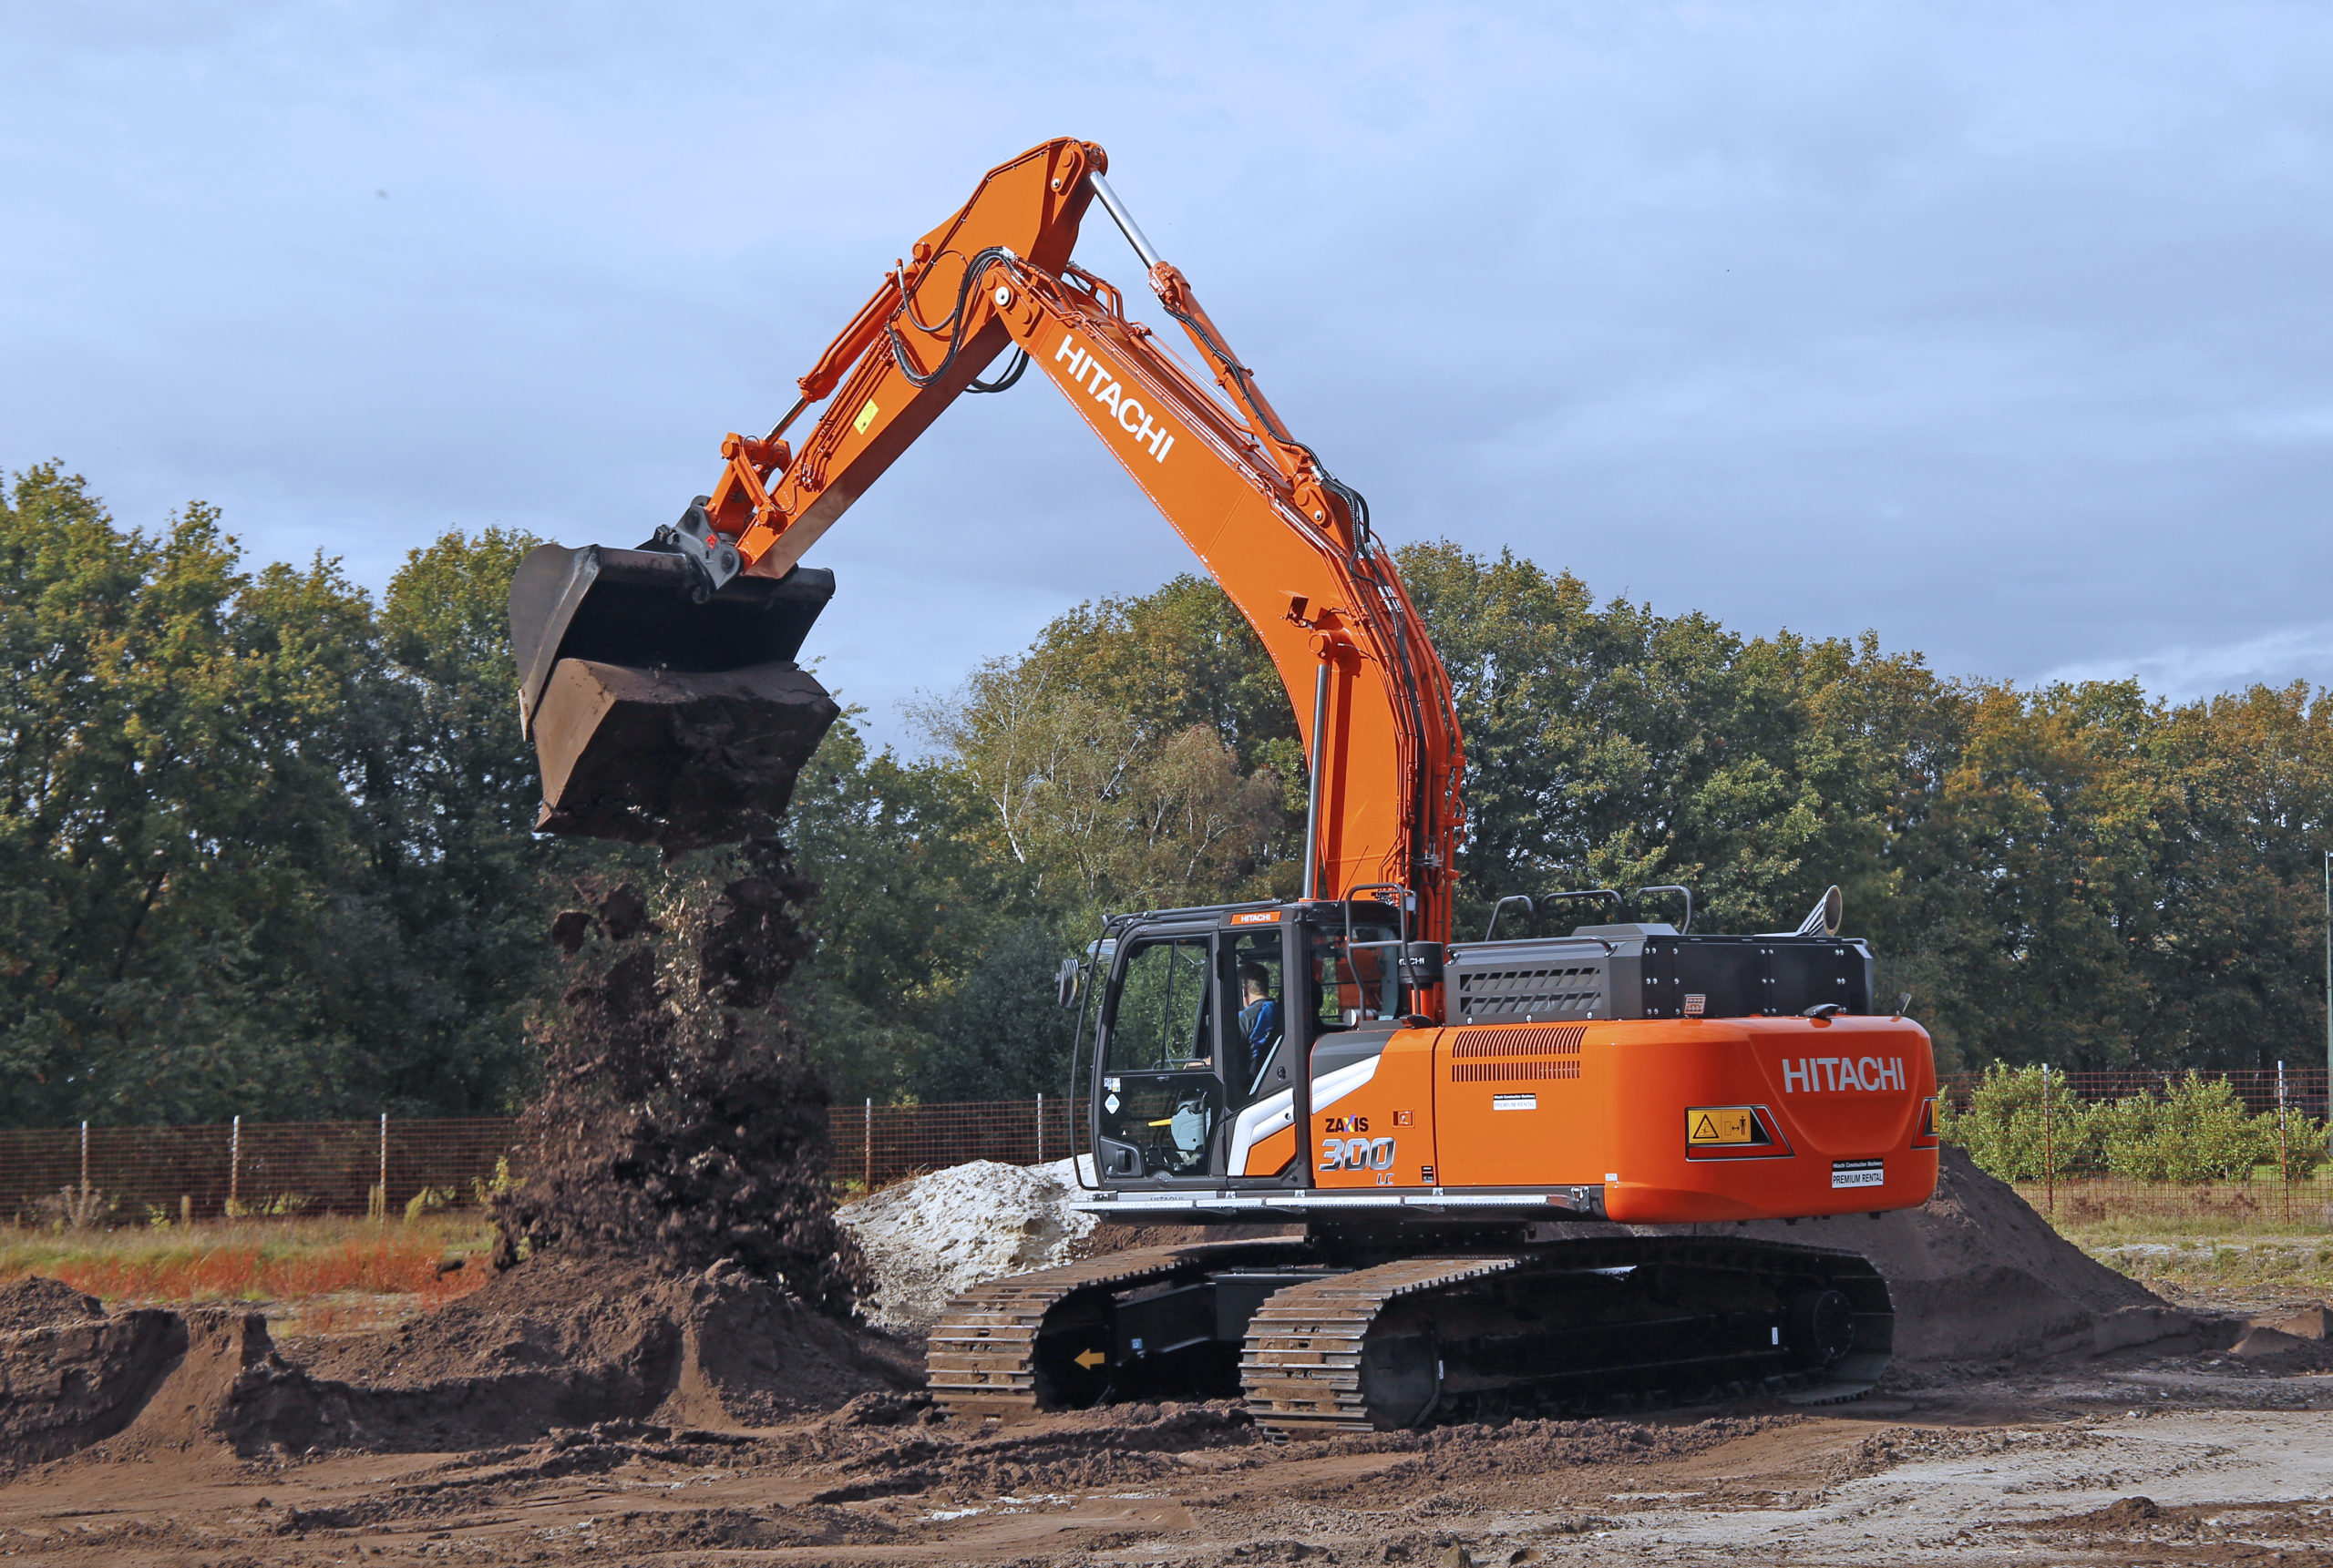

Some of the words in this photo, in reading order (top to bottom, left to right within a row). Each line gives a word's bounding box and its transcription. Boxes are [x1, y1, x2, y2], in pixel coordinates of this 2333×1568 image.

[1054, 333, 1176, 464] HITACHI
[1240, 914, 1271, 923] HITACHI
[1782, 1057, 1906, 1093] HITACHI
[1325, 1114, 1369, 1132] ZAXIS
[1319, 1137, 1396, 1172] 300
[1376, 1173, 1394, 1184] LC
[1833, 1174, 1861, 1184] PREMIUM
[1862, 1173, 1883, 1184] RENTAL
